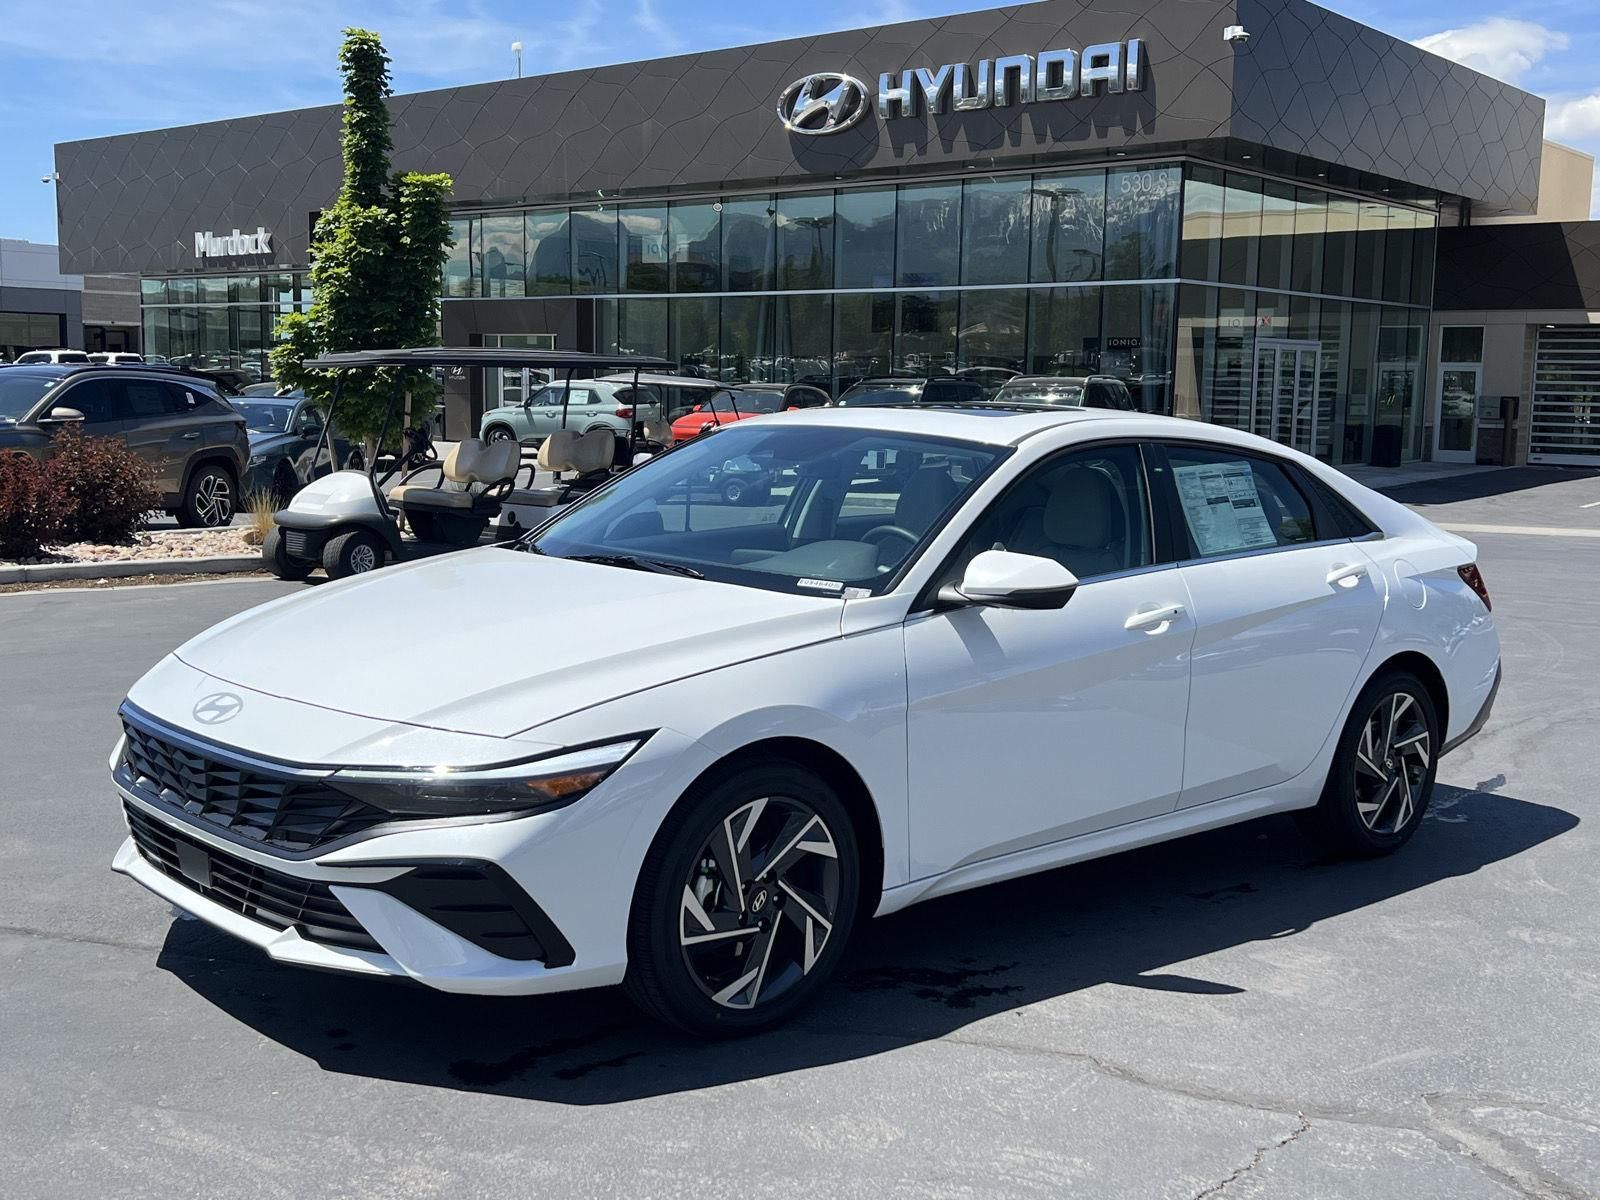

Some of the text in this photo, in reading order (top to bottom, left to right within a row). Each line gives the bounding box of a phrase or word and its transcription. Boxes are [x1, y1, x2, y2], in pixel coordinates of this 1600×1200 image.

[878, 38, 1145, 120] HYUNDAI
[1121, 173, 1152, 193] 530
[194, 226, 272, 258] Murdock
